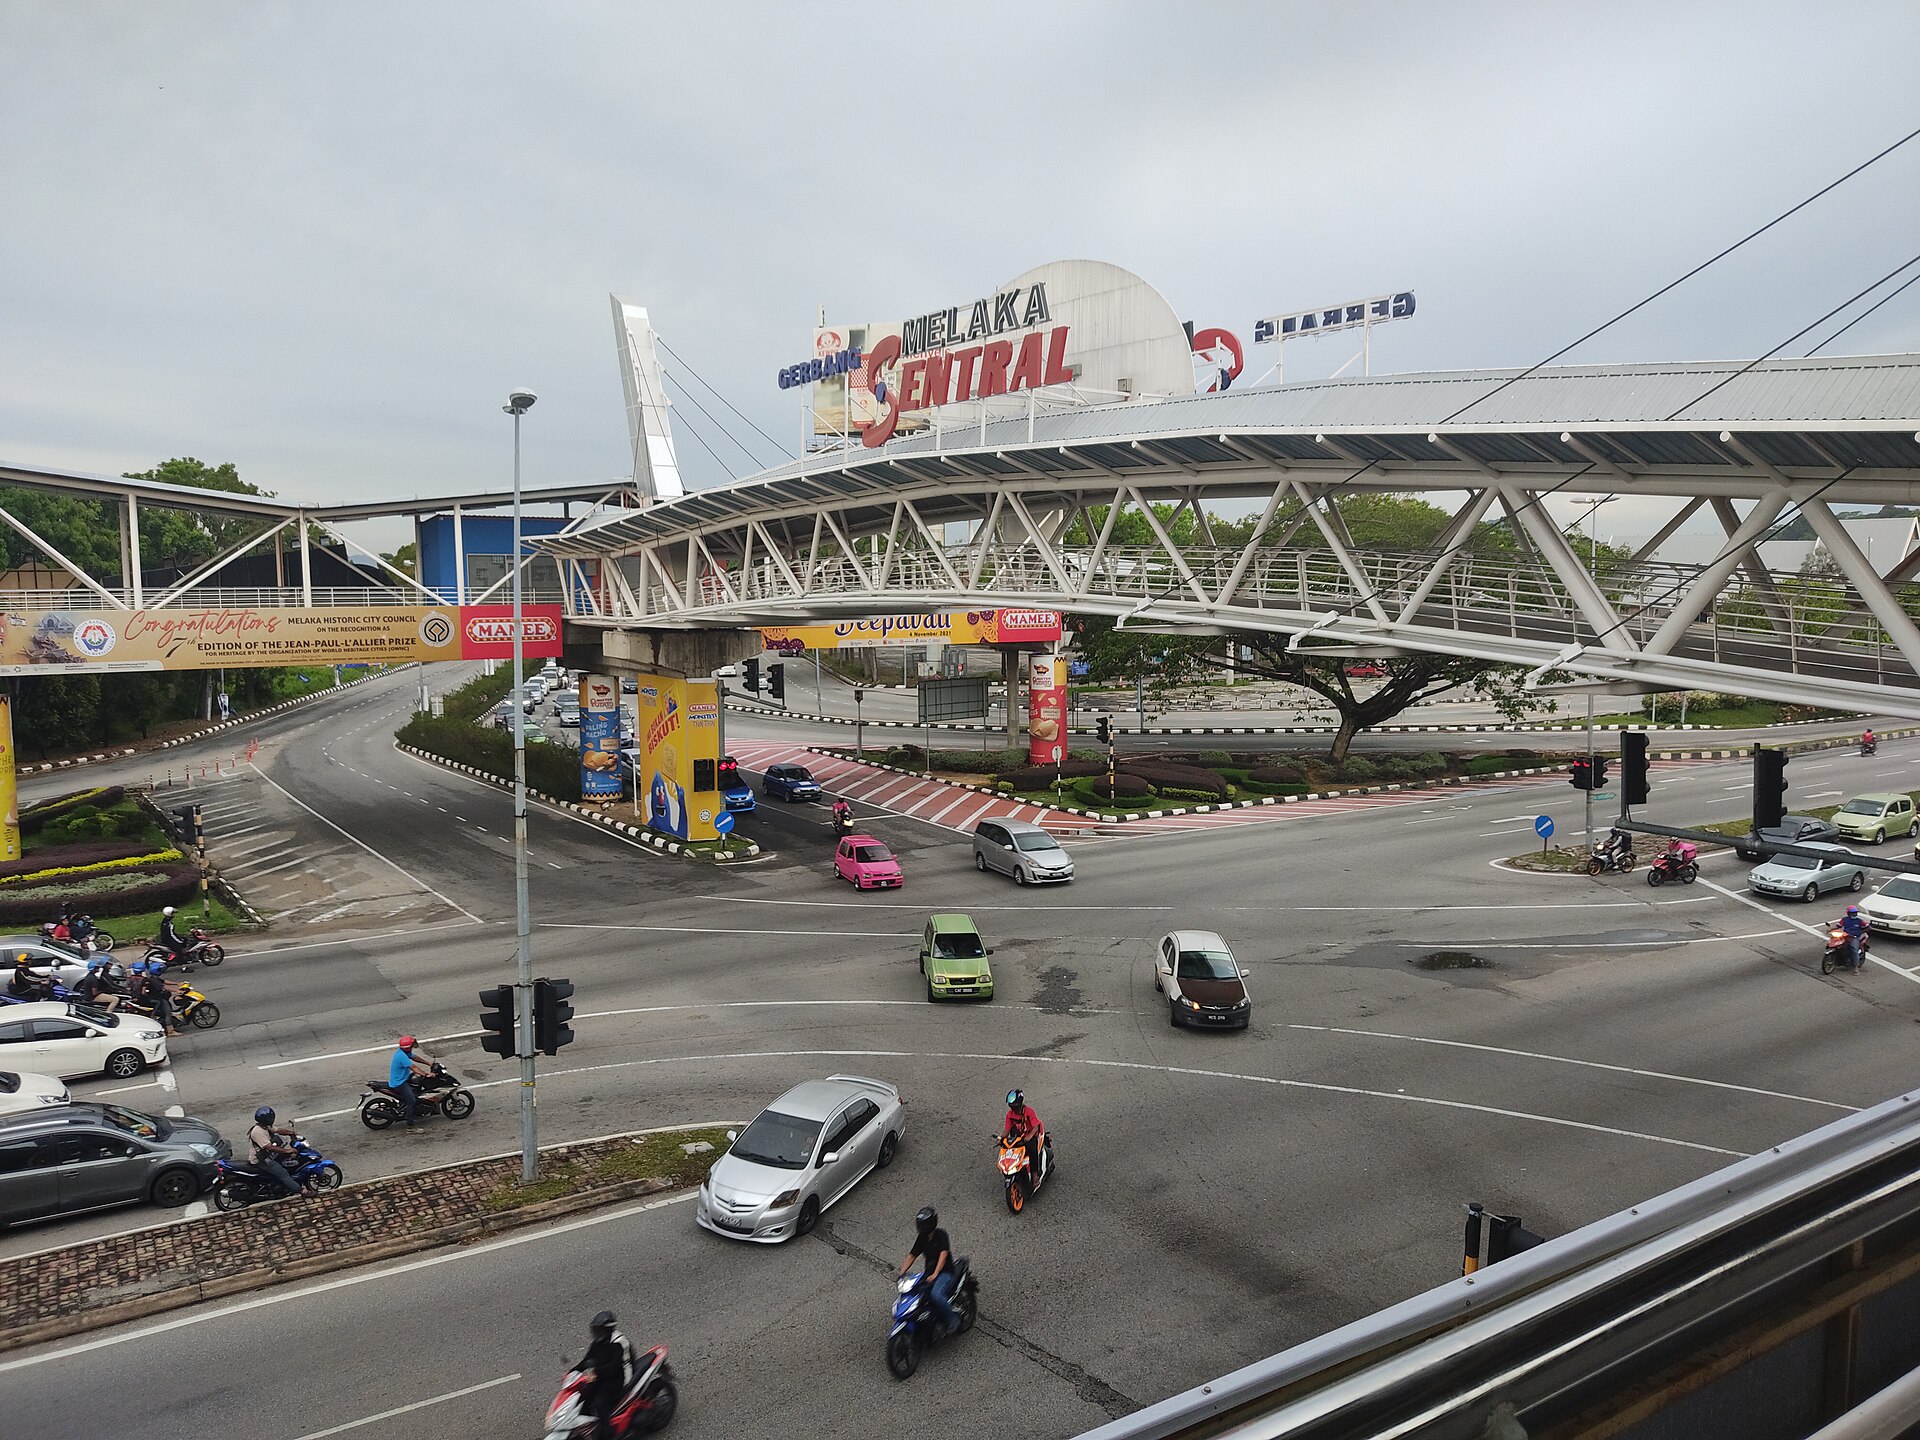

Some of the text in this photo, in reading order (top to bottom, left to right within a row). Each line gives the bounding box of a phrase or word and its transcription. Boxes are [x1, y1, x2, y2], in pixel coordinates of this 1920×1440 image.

[901, 281, 1052, 355] MELAKA
[778, 346, 861, 390] GERBANG
[862, 325, 1075, 448] SENTRAL
[124, 608, 281, 648] Congratulations
[288, 617, 321, 625] MELAKA
[324, 616, 360, 624] HISTORIC
[383, 615, 416, 623] COUNCIL
[478, 623, 546, 637] MAEE
[1009, 614, 1052, 625] MAMEE
[198, 641, 242, 651] EDITION
[245, 641, 259, 650] OF
[262, 640, 283, 649] THE
[389, 637, 416, 645] PRIZE
